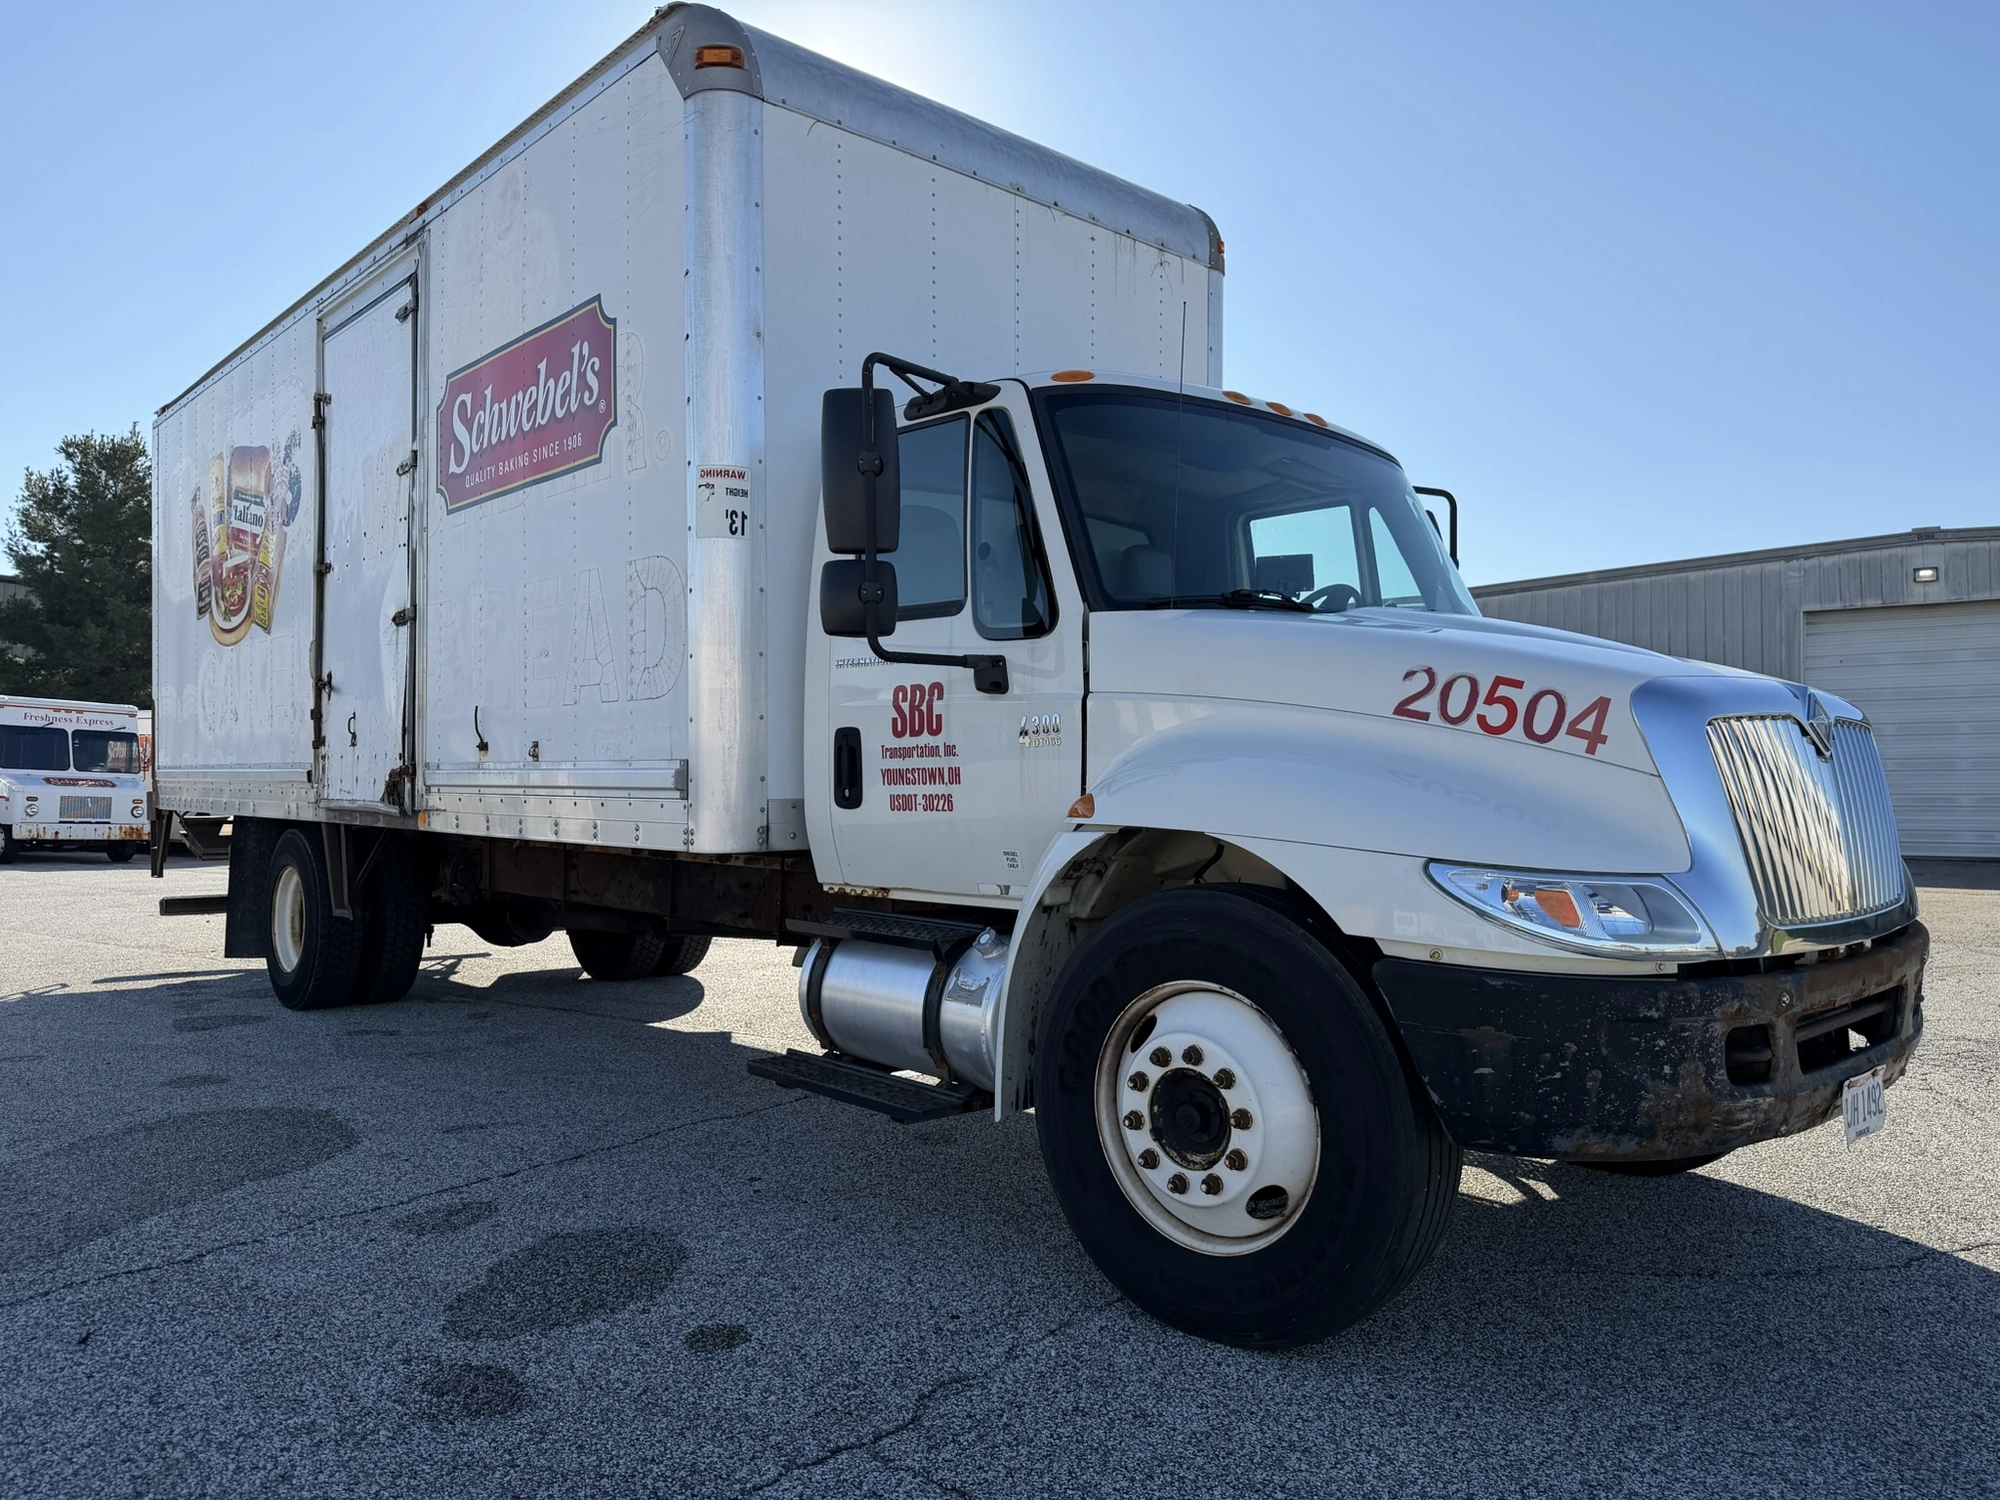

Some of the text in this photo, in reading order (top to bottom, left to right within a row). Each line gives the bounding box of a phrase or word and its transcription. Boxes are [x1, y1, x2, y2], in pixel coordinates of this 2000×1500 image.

[448, 339, 600, 475] Schwebel's
[466, 432, 582, 488] QUALITY BAKING SINCE 1906
[23, 712, 114, 727] Freshness Express
[891, 681, 945, 739] SBC
[1392, 665, 1612, 756] 20504
[880, 741, 959, 760] Transportation, Inc.
[889, 793, 954, 812] USDOT-30226
[1002, 850, 1019, 858] DIESEL
[1862, 1081, 1884, 1122] 1492
